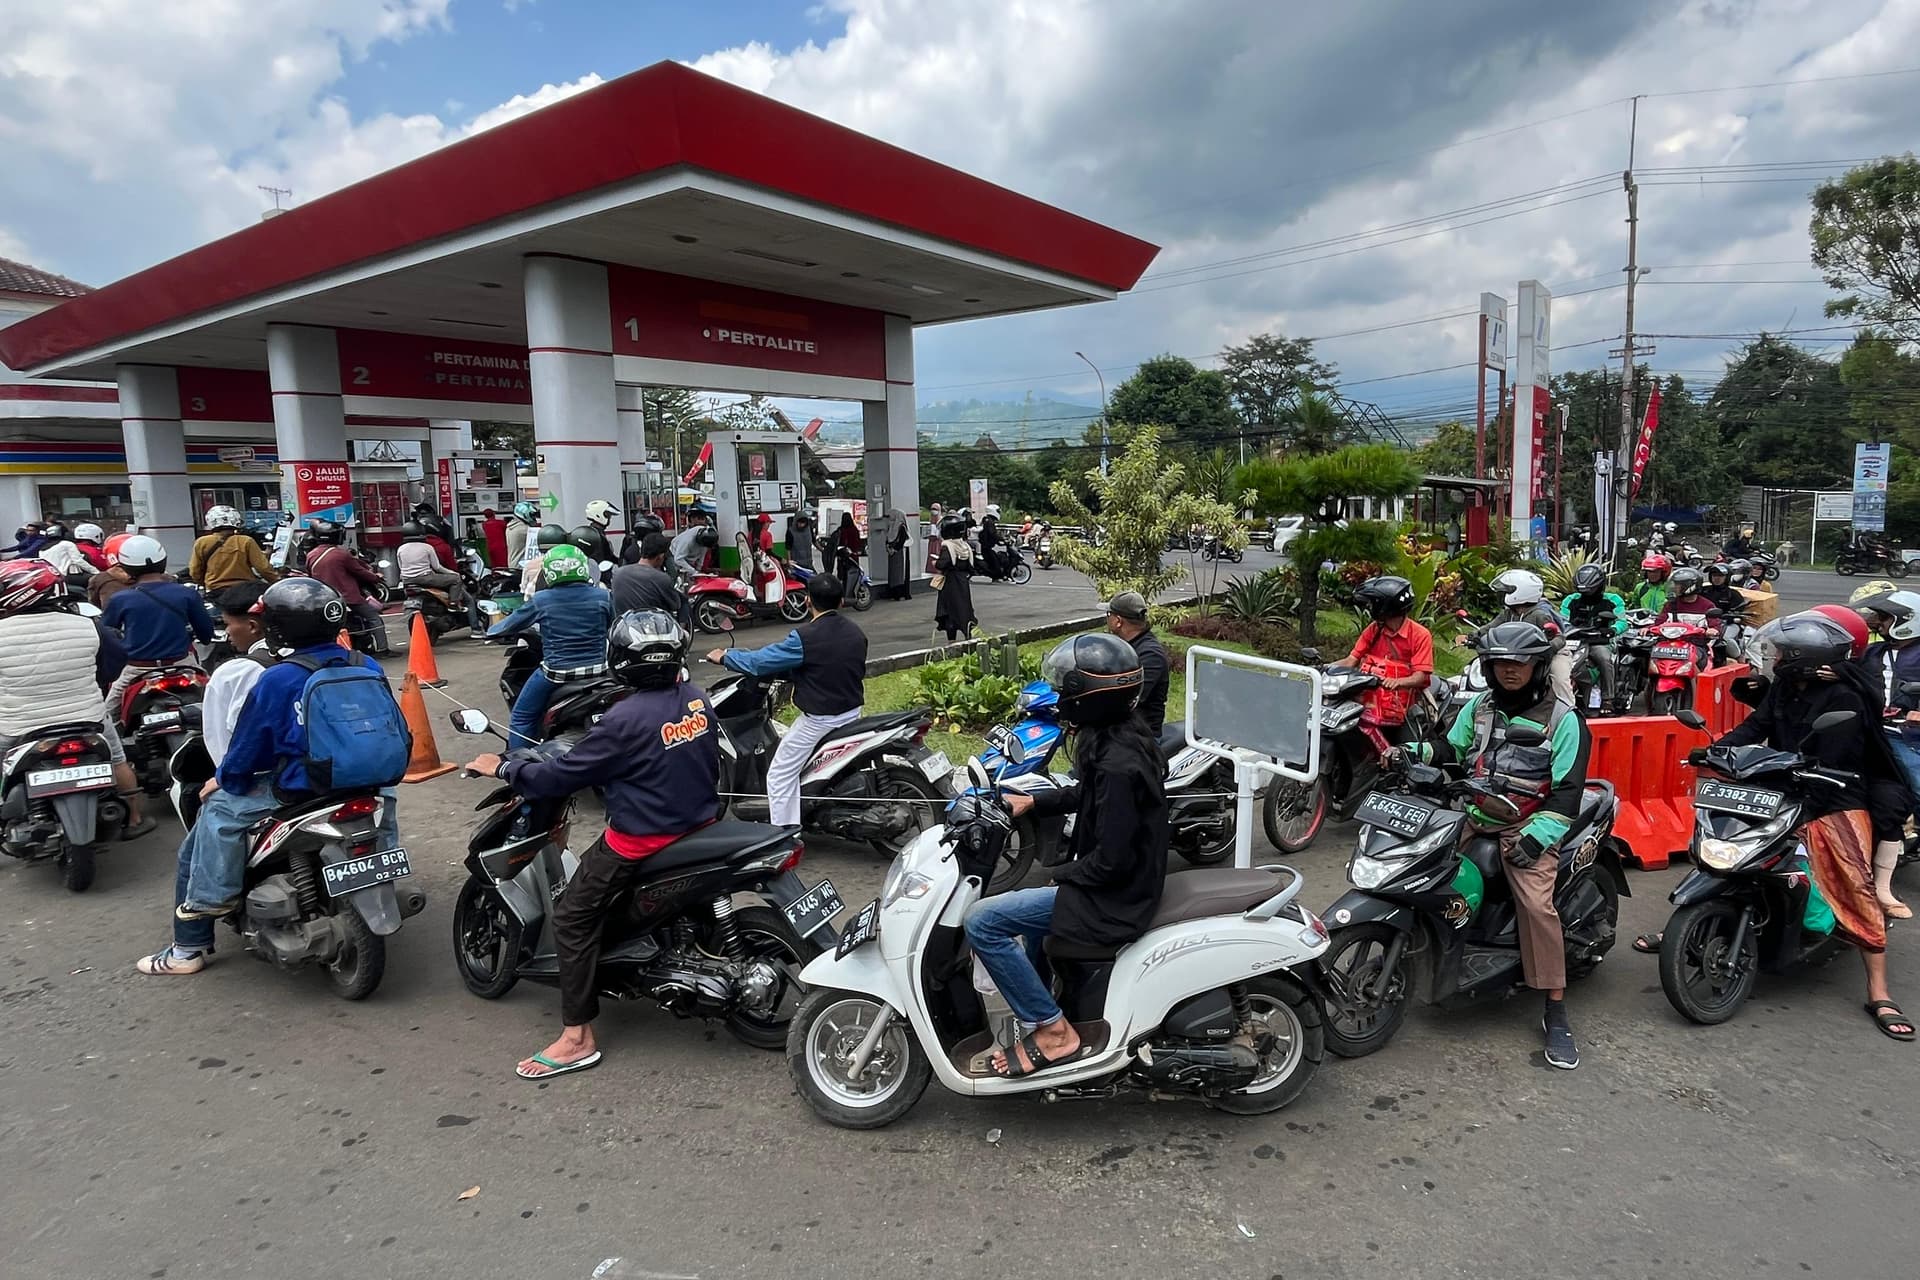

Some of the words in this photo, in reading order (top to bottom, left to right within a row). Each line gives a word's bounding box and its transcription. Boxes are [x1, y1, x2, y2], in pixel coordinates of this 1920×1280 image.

[624, 317, 639, 341] 1
[717, 328, 816, 354] PERTALITE
[433, 351, 520, 370] PERTAMINA
[352, 366, 371, 385] 2
[435, 372, 529, 390] PERTAMA
[191, 397, 207, 412] 3
[315, 467, 345, 475] JALUR
[661, 712, 707, 745] Prajab
[33, 774, 41, 784] F
[49, 769, 81, 781] 3793
[86, 765, 108, 777] FCR
[1703, 785, 1713, 795] F
[1717, 788, 1748, 801] 3382
[1366, 796, 1377, 807] F
[1377, 800, 1404, 816] 6454
[325, 868, 337, 882] B
[342, 858, 375, 875] 4604
[381, 851, 406, 866] BCR
[1404, 876, 1430, 890] HONDA
[787, 909, 797, 924] F
[796, 894, 819, 916] 3445
